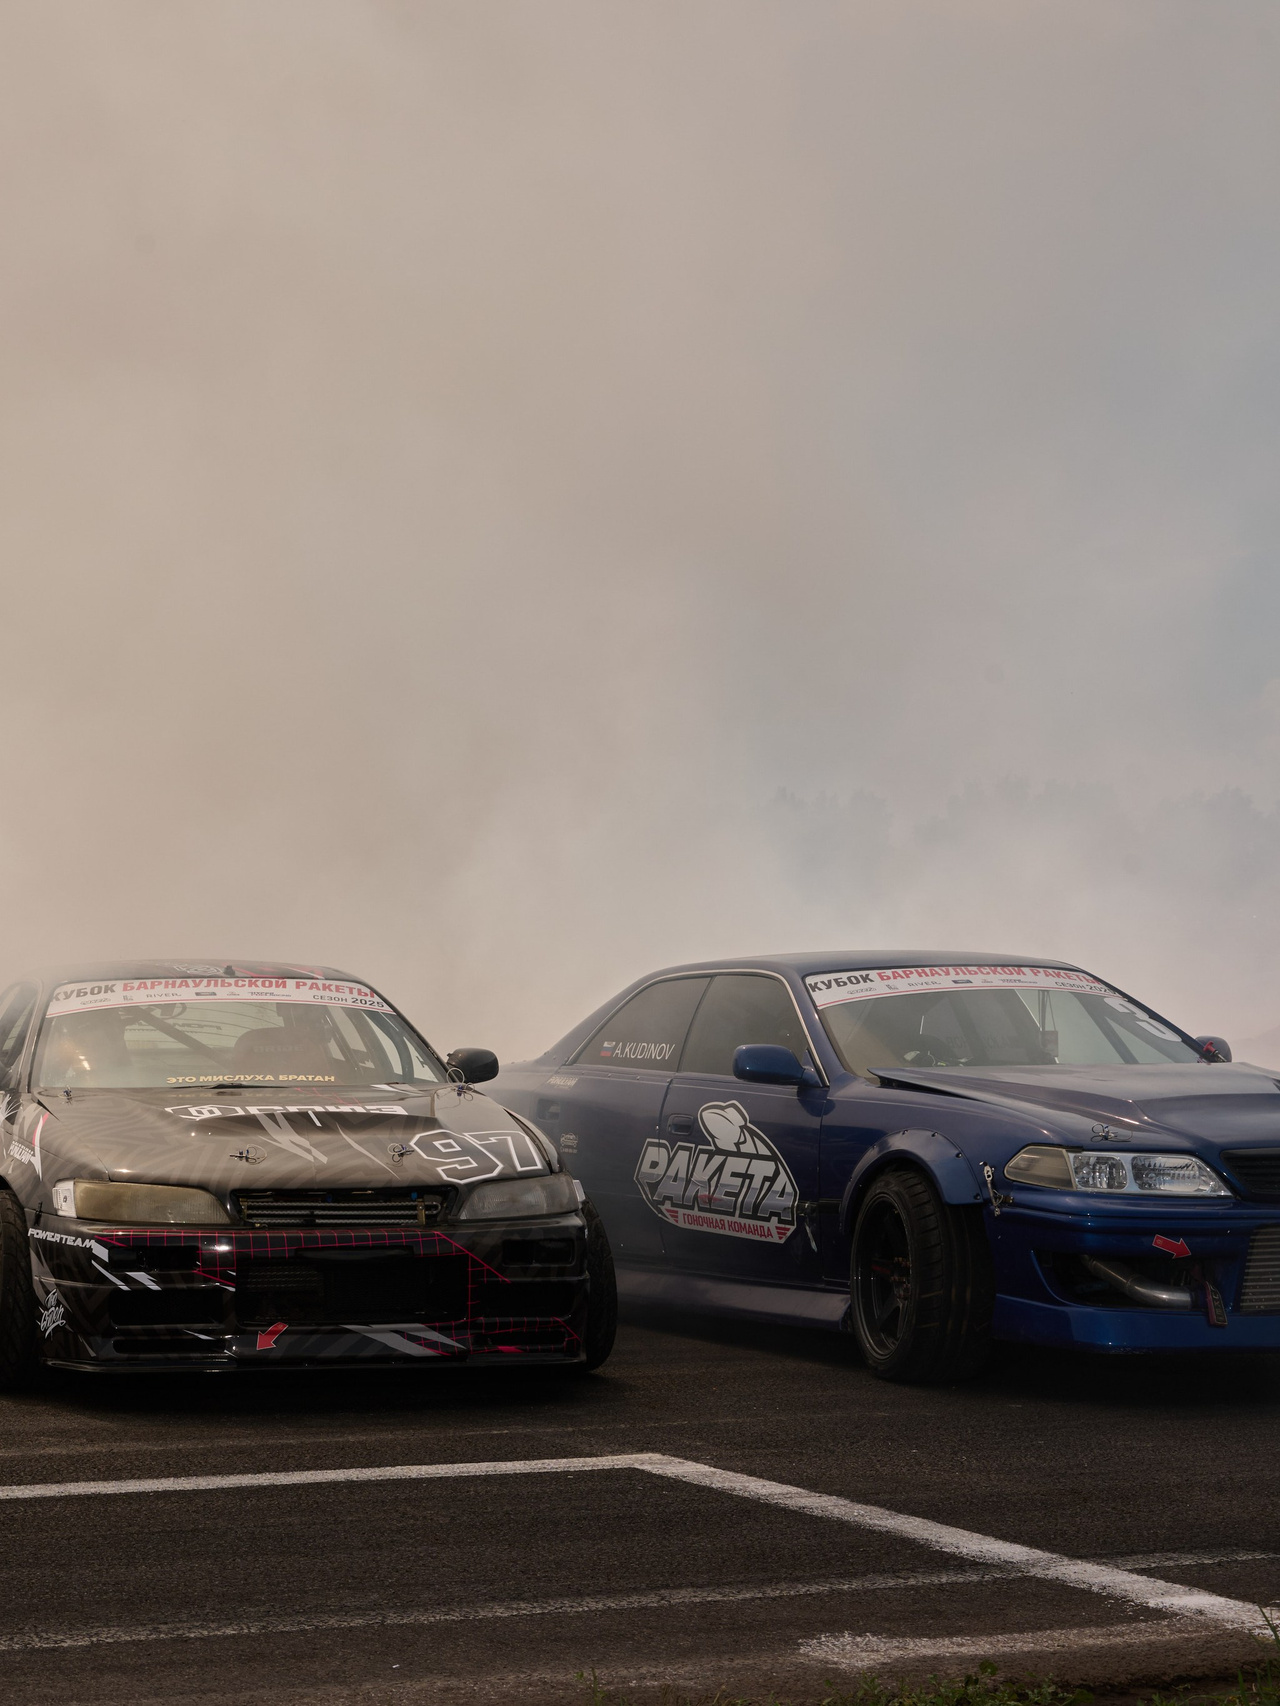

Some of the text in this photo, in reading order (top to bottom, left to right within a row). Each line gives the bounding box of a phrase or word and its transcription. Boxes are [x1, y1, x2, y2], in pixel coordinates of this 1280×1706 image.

[53, 978, 376, 1001] КУБОК БАРНАУЛЬСКОЙ РАКЕТЫ
[808, 973, 874, 993] КУБОК
[876, 966, 1026, 982] БАРНАУЛЬСКОЙ
[1028, 967, 1101, 985] РАКЕТЫ
[1054, 981, 1085, 990] СЕЗОН
[313, 994, 385, 1008] СЕЗОН 2025
[613, 1042, 676, 1060] A.KUDINOV
[278, 1074, 335, 1082] БРАТАН
[409, 1129, 544, 1184] 97
[637, 1144, 796, 1221] РАКЕТА
[683, 1212, 774, 1239] ГОНОЧНАЯ КОМАНДА
[27, 1228, 95, 1249] POWERTEAM
